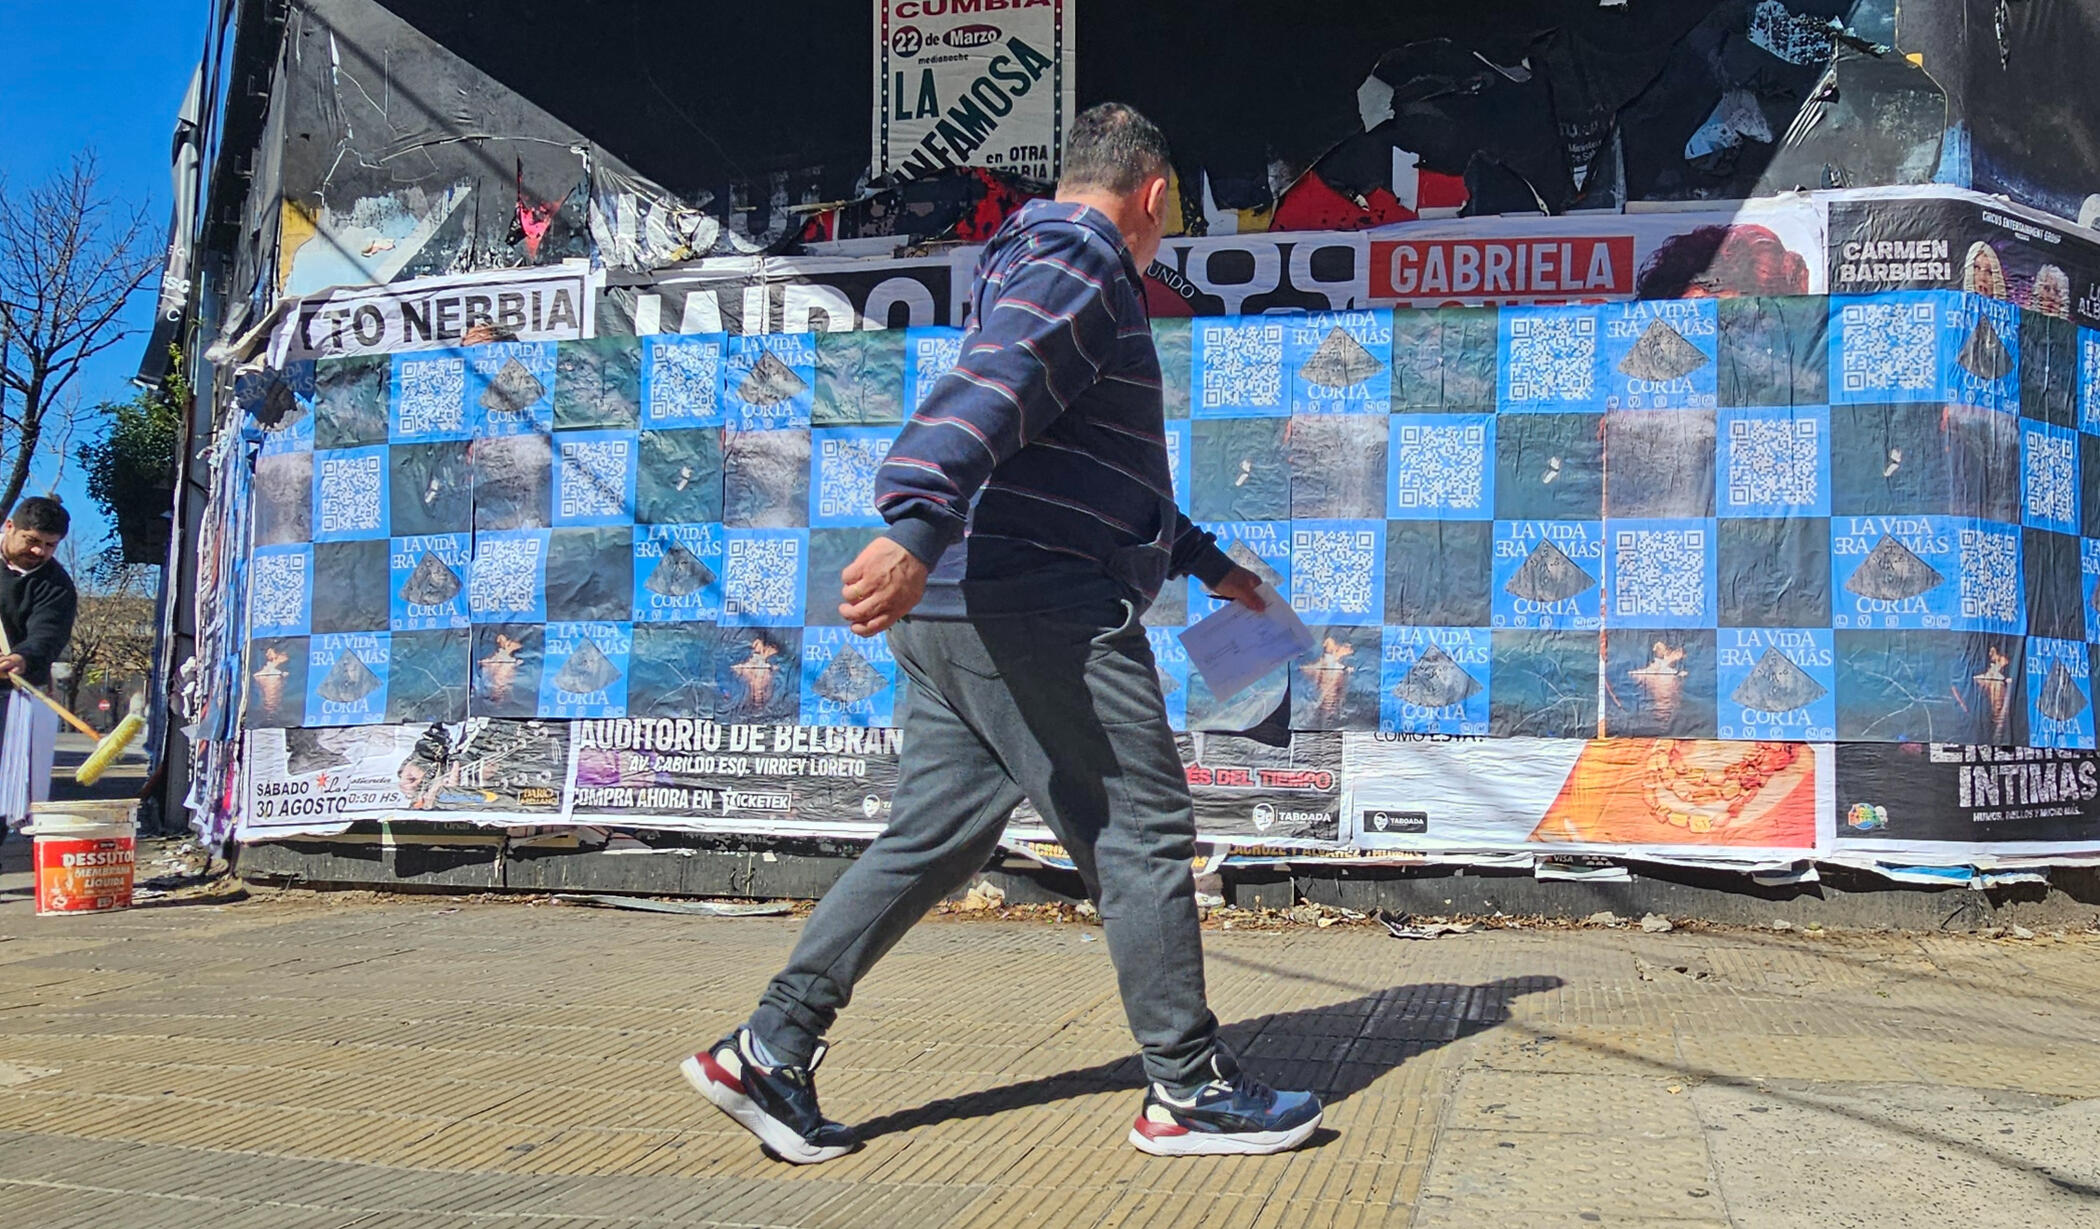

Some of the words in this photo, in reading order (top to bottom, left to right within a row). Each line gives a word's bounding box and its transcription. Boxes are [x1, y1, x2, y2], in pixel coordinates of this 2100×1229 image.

[895, 31, 919, 53] 22
[925, 32, 940, 46] de
[950, 30, 998, 46] Marzo
[918, 53, 969, 65] medianoche
[895, 68, 940, 121] LA
[986, 153, 1003, 164] en
[1009, 144, 1048, 161] OTRA
[1982, 210, 2003, 227] CIRCUS
[2002, 216, 2045, 240] ENTERTAINMENT
[2044, 230, 2062, 244] GROUP
[1842, 239, 1949, 261] CARMEN
[1390, 241, 1616, 294] GABRIELA
[1839, 262, 1951, 282] BARBIERI
[400, 288, 579, 343] NEBBIA
[1622, 303, 1648, 319] LA
[1650, 300, 1700, 319] VIDA
[1306, 314, 1329, 328] LA
[1332, 310, 1378, 328] VIDA
[742, 339, 760, 353] LA
[763, 335, 803, 351] VIDA
[1306, 384, 1370, 401] CORTA
[1626, 378, 1695, 395] CORTA
[648, 526, 668, 540] LA
[673, 525, 712, 541] VIDA
[1234, 522, 1277, 539] VIDA
[1511, 523, 1536, 539] LA
[1537, 522, 1587, 539] VIDA
[1850, 518, 1877, 536] LA
[1879, 517, 1934, 536] VIDA
[403, 539, 421, 553] LA
[424, 535, 458, 551] VIDA
[407, 603, 458, 618] CORTA
[650, 594, 703, 609] CORTA
[1513, 598, 1580, 616] CORTA
[1855, 595, 1930, 614] CORTA
[560, 624, 578, 639] LA
[579, 622, 619, 638] VIDA
[819, 629, 839, 644] LA
[1399, 630, 1424, 646] LA
[1428, 629, 1475, 646] VIDA
[1736, 630, 1762, 648] LA
[1763, 630, 1817, 648] VIDA
[323, 635, 342, 650] LA
[343, 633, 379, 649] VIDA
[321, 699, 370, 714] CORTA
[555, 690, 610, 705] CORTA
[819, 698, 875, 715] CORTA
[1401, 703, 1468, 720] CORTA
[1741, 708, 1813, 726] CORTA
[580, 718, 722, 752] AUDITORIO
[728, 724, 766, 753] DE
[774, 725, 904, 755] BELGRAN
[629, 756, 649, 772] AV.
[653, 757, 715, 773] CABILDO
[717, 757, 750, 777] ESQ.
[755, 757, 810, 776] VIRREY
[810, 759, 866, 777] LORETO
[256, 779, 310, 797] SÁBADO
[1215, 768, 1256, 786] DEL
[1257, 769, 1332, 790] TIEMPO
[1959, 760, 2098, 808] INTIMAS
[256, 800, 274, 818] 30
[279, 796, 347, 817] AGOSTO
[348, 793, 377, 804] 0:30
[379, 792, 401, 803] HS.
[574, 787, 634, 807] COMPRA
[636, 788, 690, 809] AHORA
[692, 789, 714, 809] EN
[727, 793, 789, 810] TICKETEK
[1278, 811, 1332, 823] TABOADA
[1390, 817, 1425, 825] TABOADA
[1553, 854, 1574, 863] VISA
